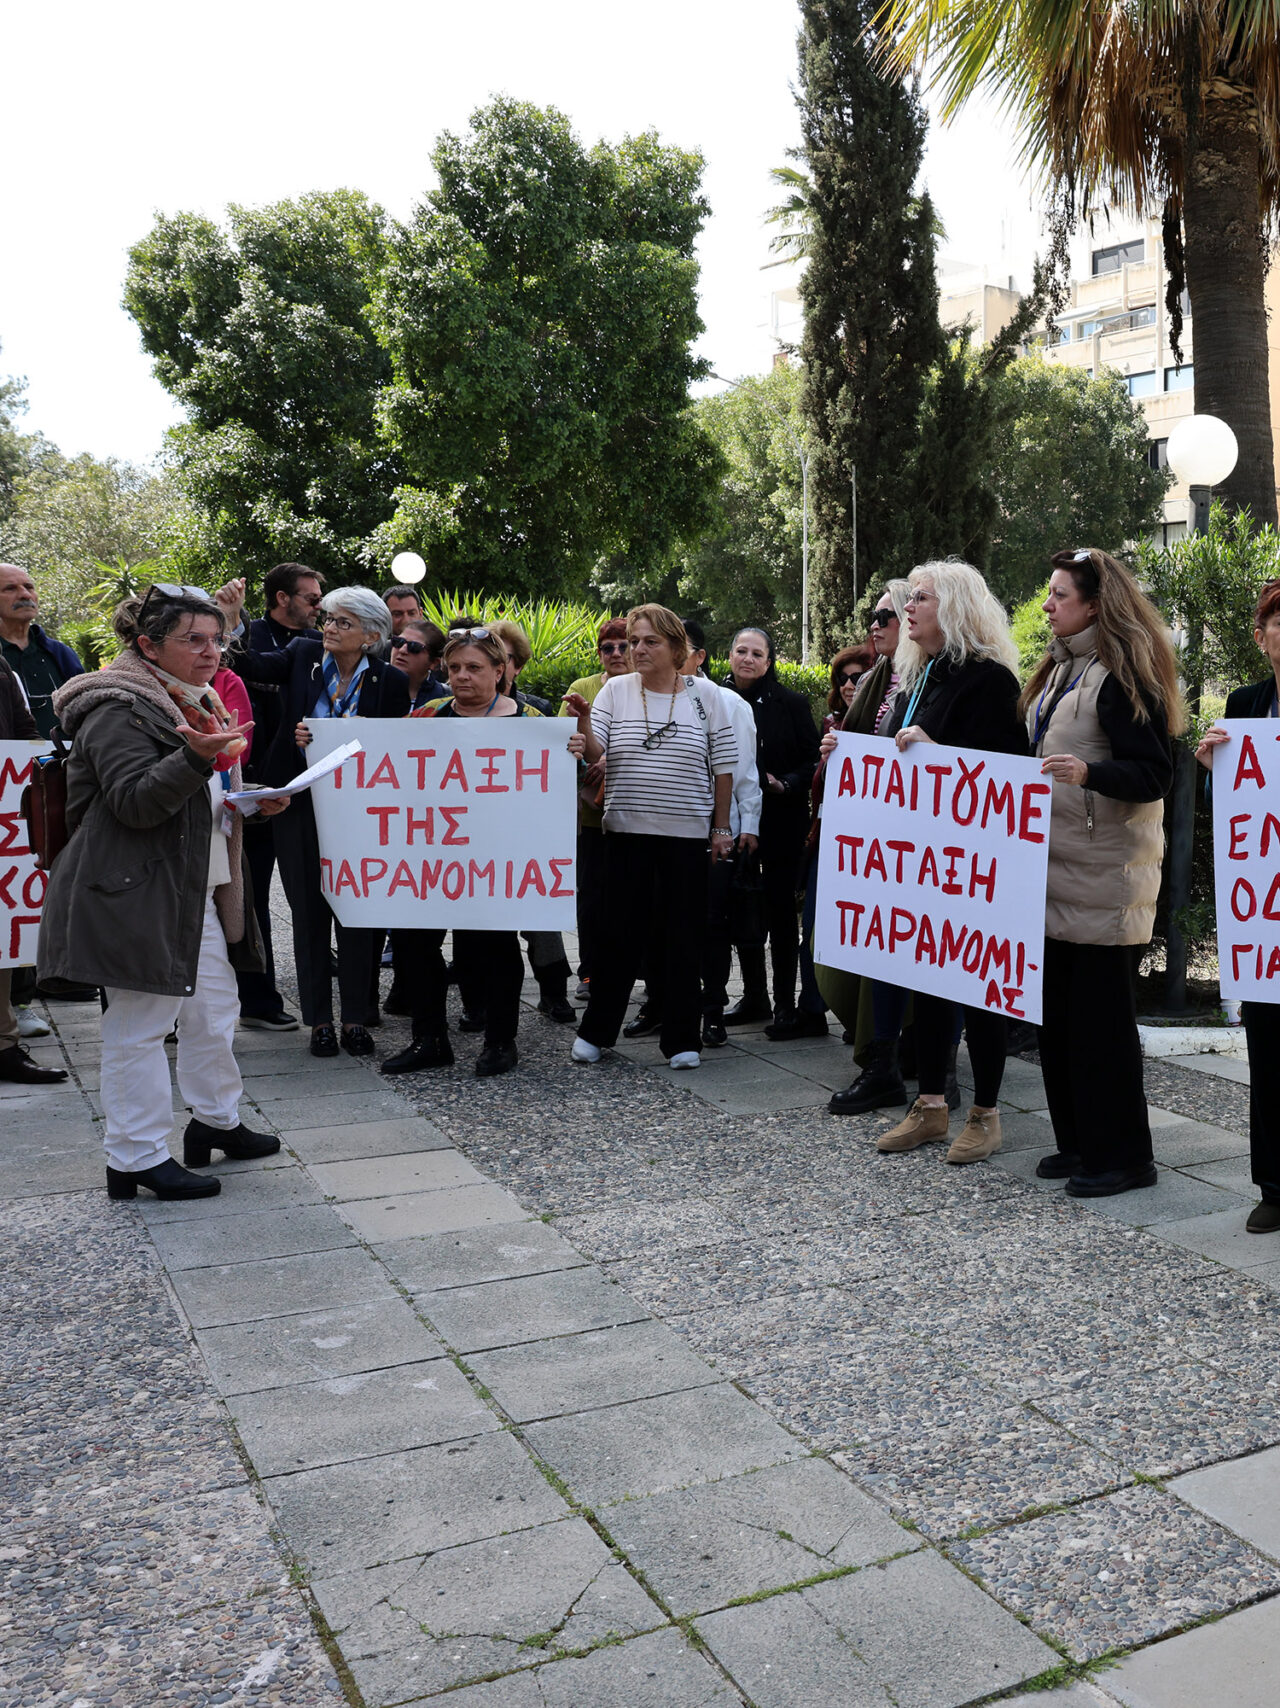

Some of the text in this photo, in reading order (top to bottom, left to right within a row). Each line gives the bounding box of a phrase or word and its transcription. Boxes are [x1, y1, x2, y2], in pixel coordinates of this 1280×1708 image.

[333, 747, 550, 794] ΠΑΤΑΞΗ
[366, 806, 470, 846] ΤΗΣ
[320, 856, 575, 901] ΠΑΡΑΝΟΜΙΑΣ
[835, 834, 997, 903] ΠΑΤΑΞΗ
[835, 900, 1039, 988] ΠΑΡΑΝΟΜΙ-
[985, 979, 1026, 1018] ΑΣ
